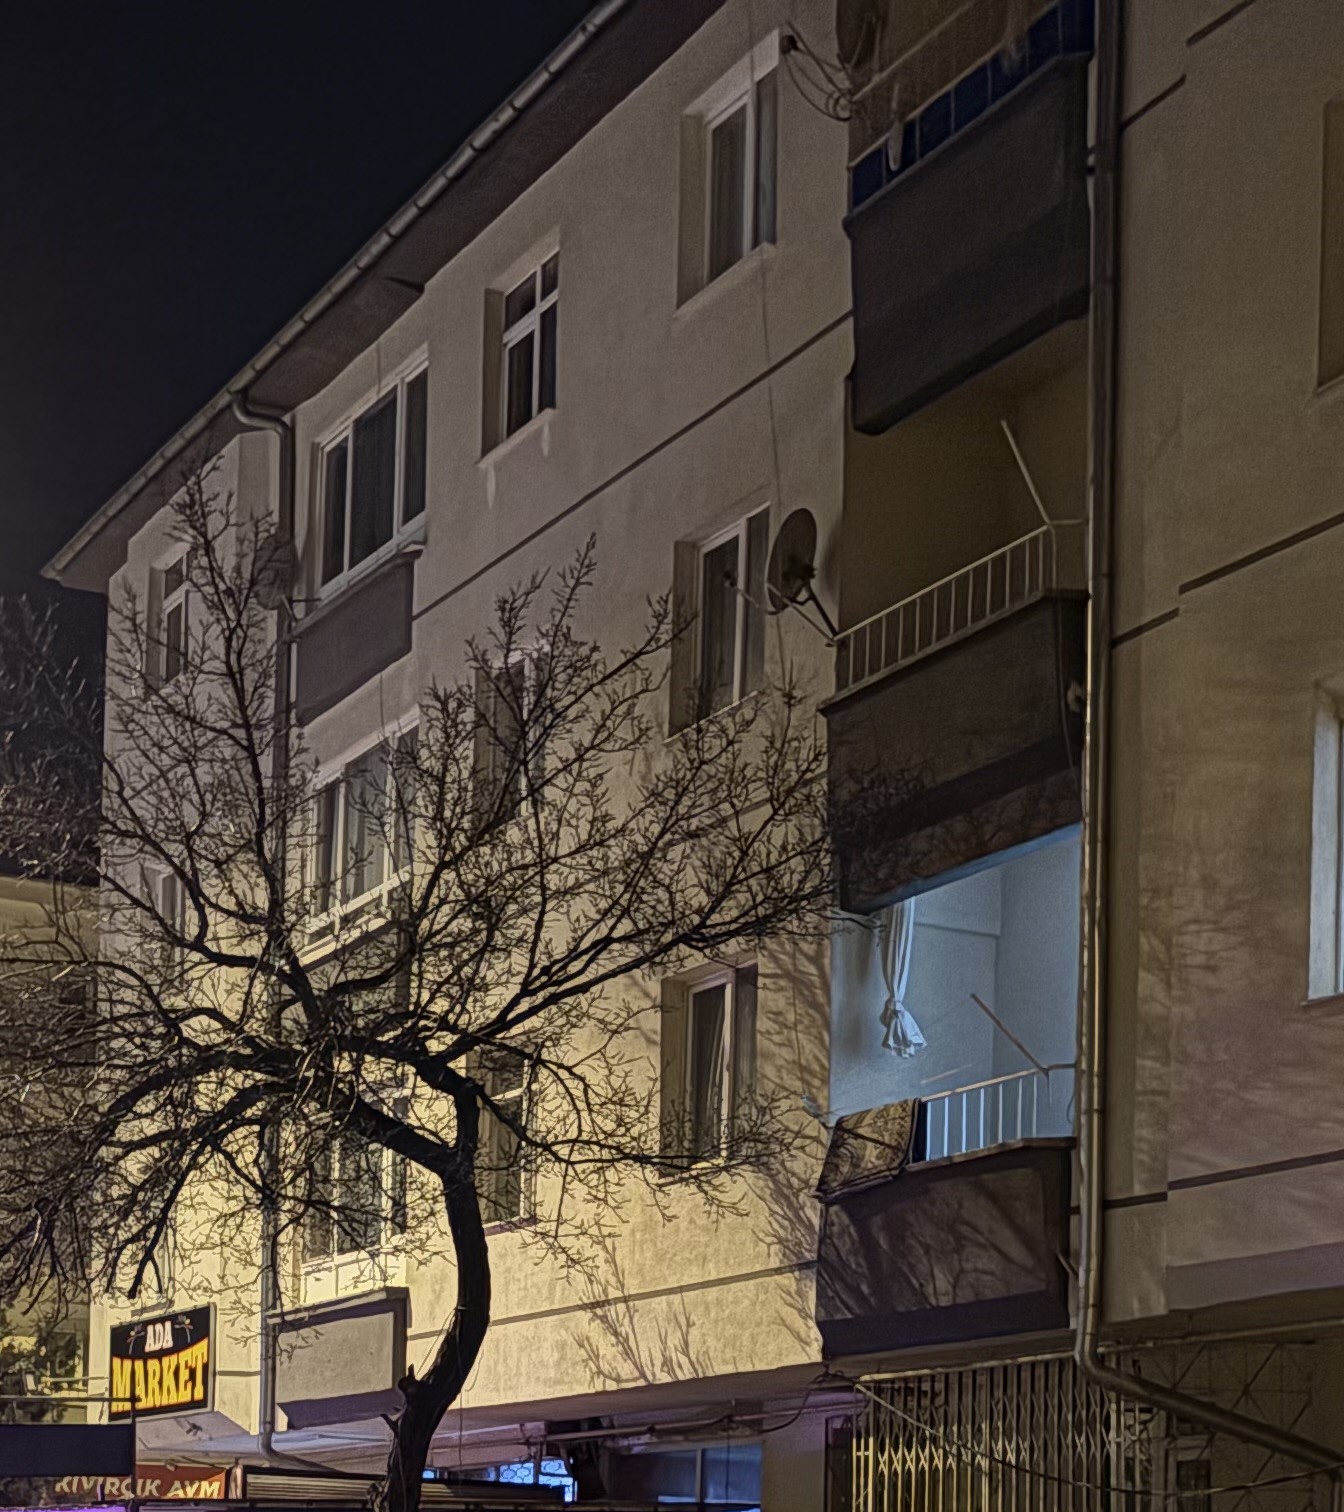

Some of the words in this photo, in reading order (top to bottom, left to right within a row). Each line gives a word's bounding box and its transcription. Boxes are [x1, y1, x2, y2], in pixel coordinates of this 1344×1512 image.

[144, 1321, 174, 1352] ADA
[110, 1336, 209, 1413] MARKET
[166, 1479, 221, 1499] AVM
